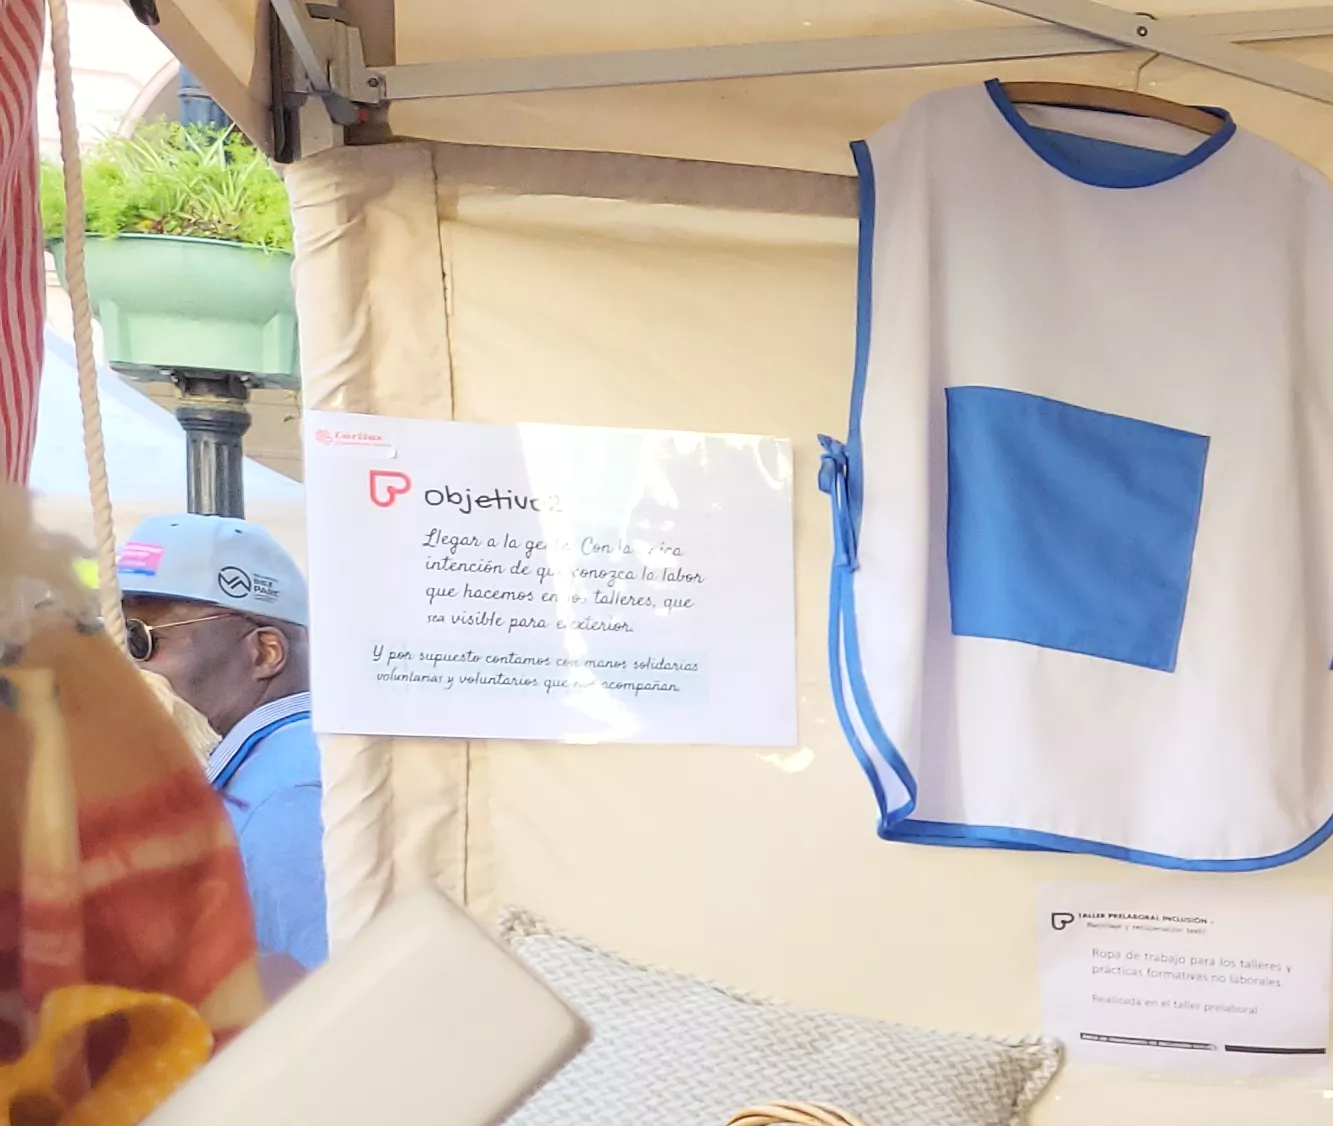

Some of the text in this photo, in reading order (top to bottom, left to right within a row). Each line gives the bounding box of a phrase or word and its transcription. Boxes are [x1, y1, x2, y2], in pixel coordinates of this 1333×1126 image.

[422, 528, 481, 555] Llegar
[487, 537, 499, 548] a
[503, 532, 519, 549] la
[581, 536, 612, 556] Con
[425, 556, 505, 574] intención
[510, 560, 532, 575] de
[641, 565, 656, 581] la
[662, 567, 704, 584] labor
[426, 587, 458, 605] que
[463, 583, 534, 602] hacemos
[593, 589, 656, 608] talleres,
[663, 598, 695, 614] que
[427, 614, 445, 623] sea
[451, 610, 504, 627] visible
[508, 617, 547, 634] para
[387, 650, 413, 666] por
[419, 649, 482, 668] supuesto
[485, 652, 551, 667] contamos
[584, 659, 627, 670] manos
[633, 656, 699, 672] solidarias
[377, 667, 443, 684] voluntarias
[444, 675, 454, 690] y
[459, 671, 538, 687] voluntarios
[544, 679, 569, 694] que
[1092, 947, 1292, 974] Ropa de trabajo para los talleres y
[1092, 964, 1143, 978] prácticas
[1147, 967, 1208, 982] formativas
[1211, 973, 1226, 983] no
[1092, 993, 1258, 1016] Realizada en el taller prelaboral
